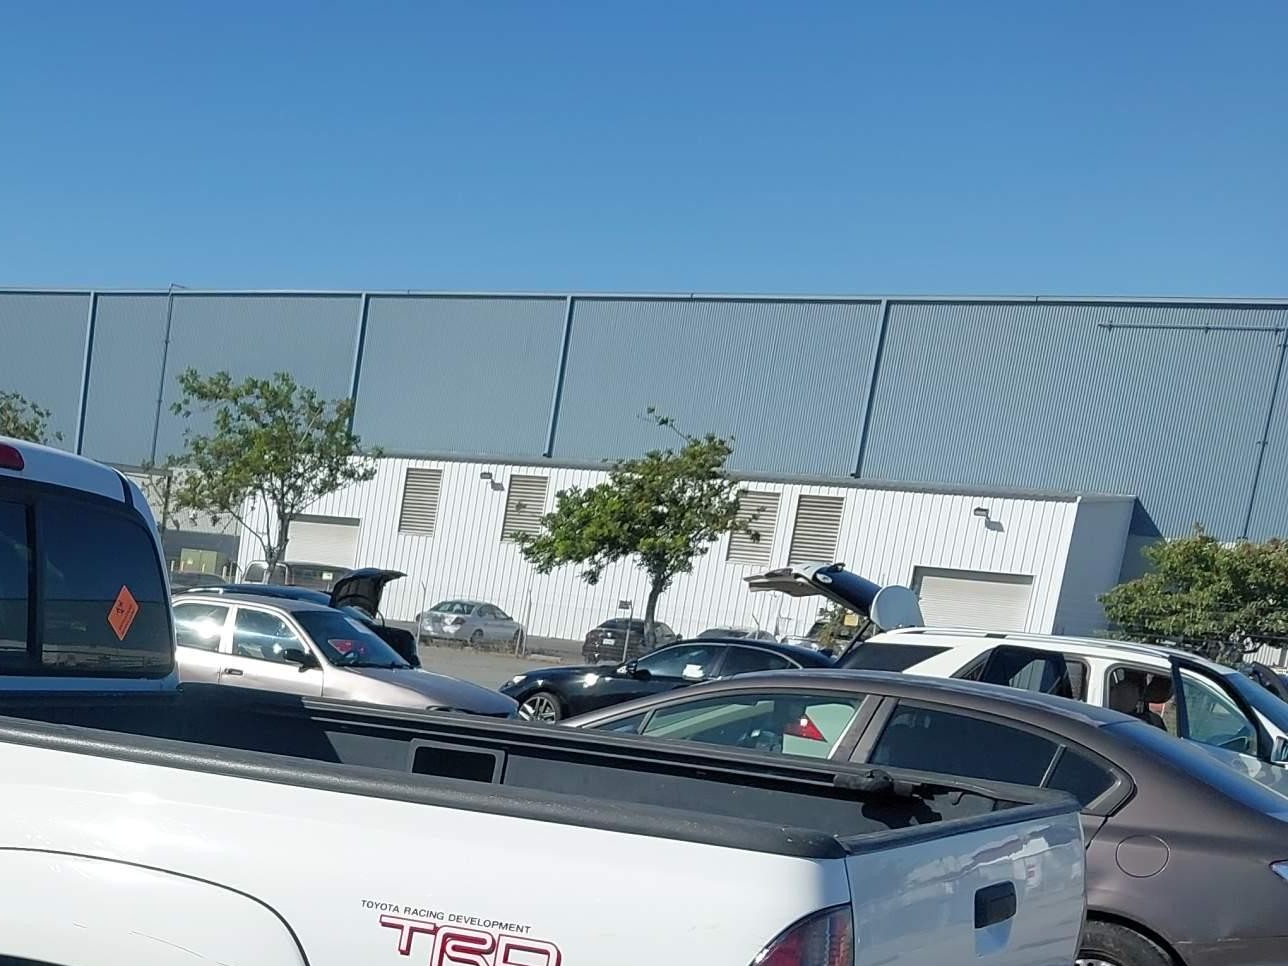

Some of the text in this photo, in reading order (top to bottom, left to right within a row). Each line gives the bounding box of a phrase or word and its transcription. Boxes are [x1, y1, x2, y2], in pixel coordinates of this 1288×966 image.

[361, 899, 532, 934] TOYOTA RACING DEVELOPMENT
